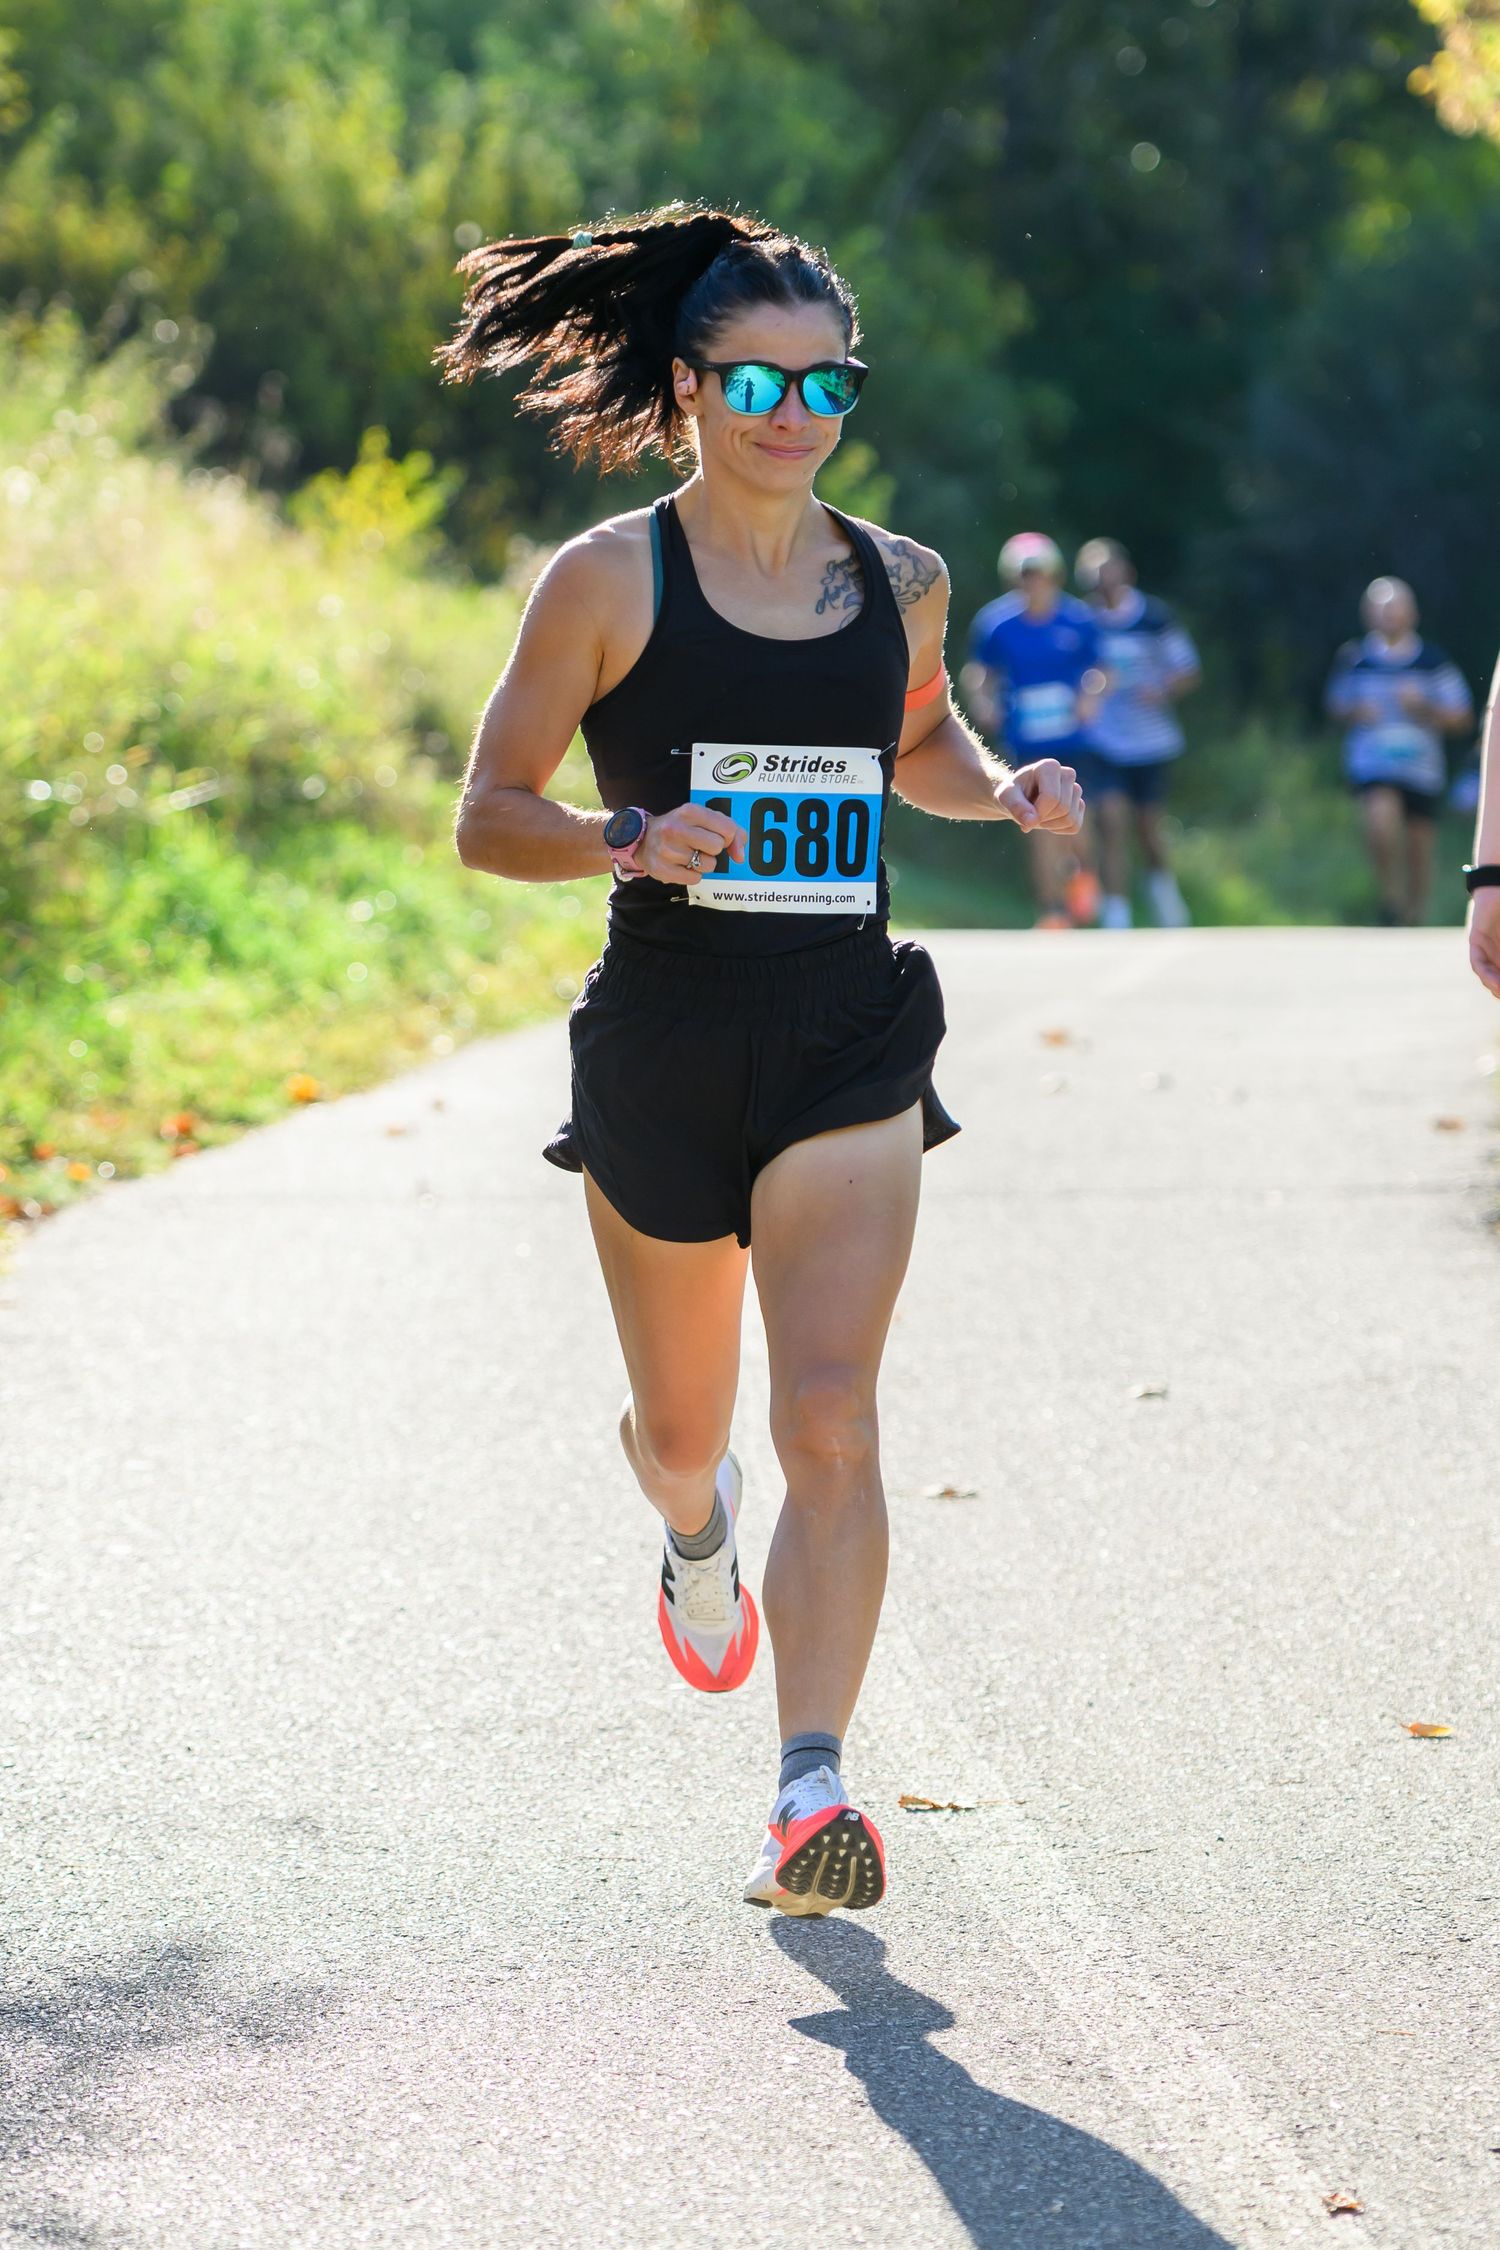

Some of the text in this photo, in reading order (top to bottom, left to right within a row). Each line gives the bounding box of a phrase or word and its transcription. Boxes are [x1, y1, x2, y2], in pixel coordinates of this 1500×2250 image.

[763, 754, 847, 773] Strides
[758, 772, 858, 784] RUNNING STORE
[713, 891, 856, 906] www.stridesrunning.com
